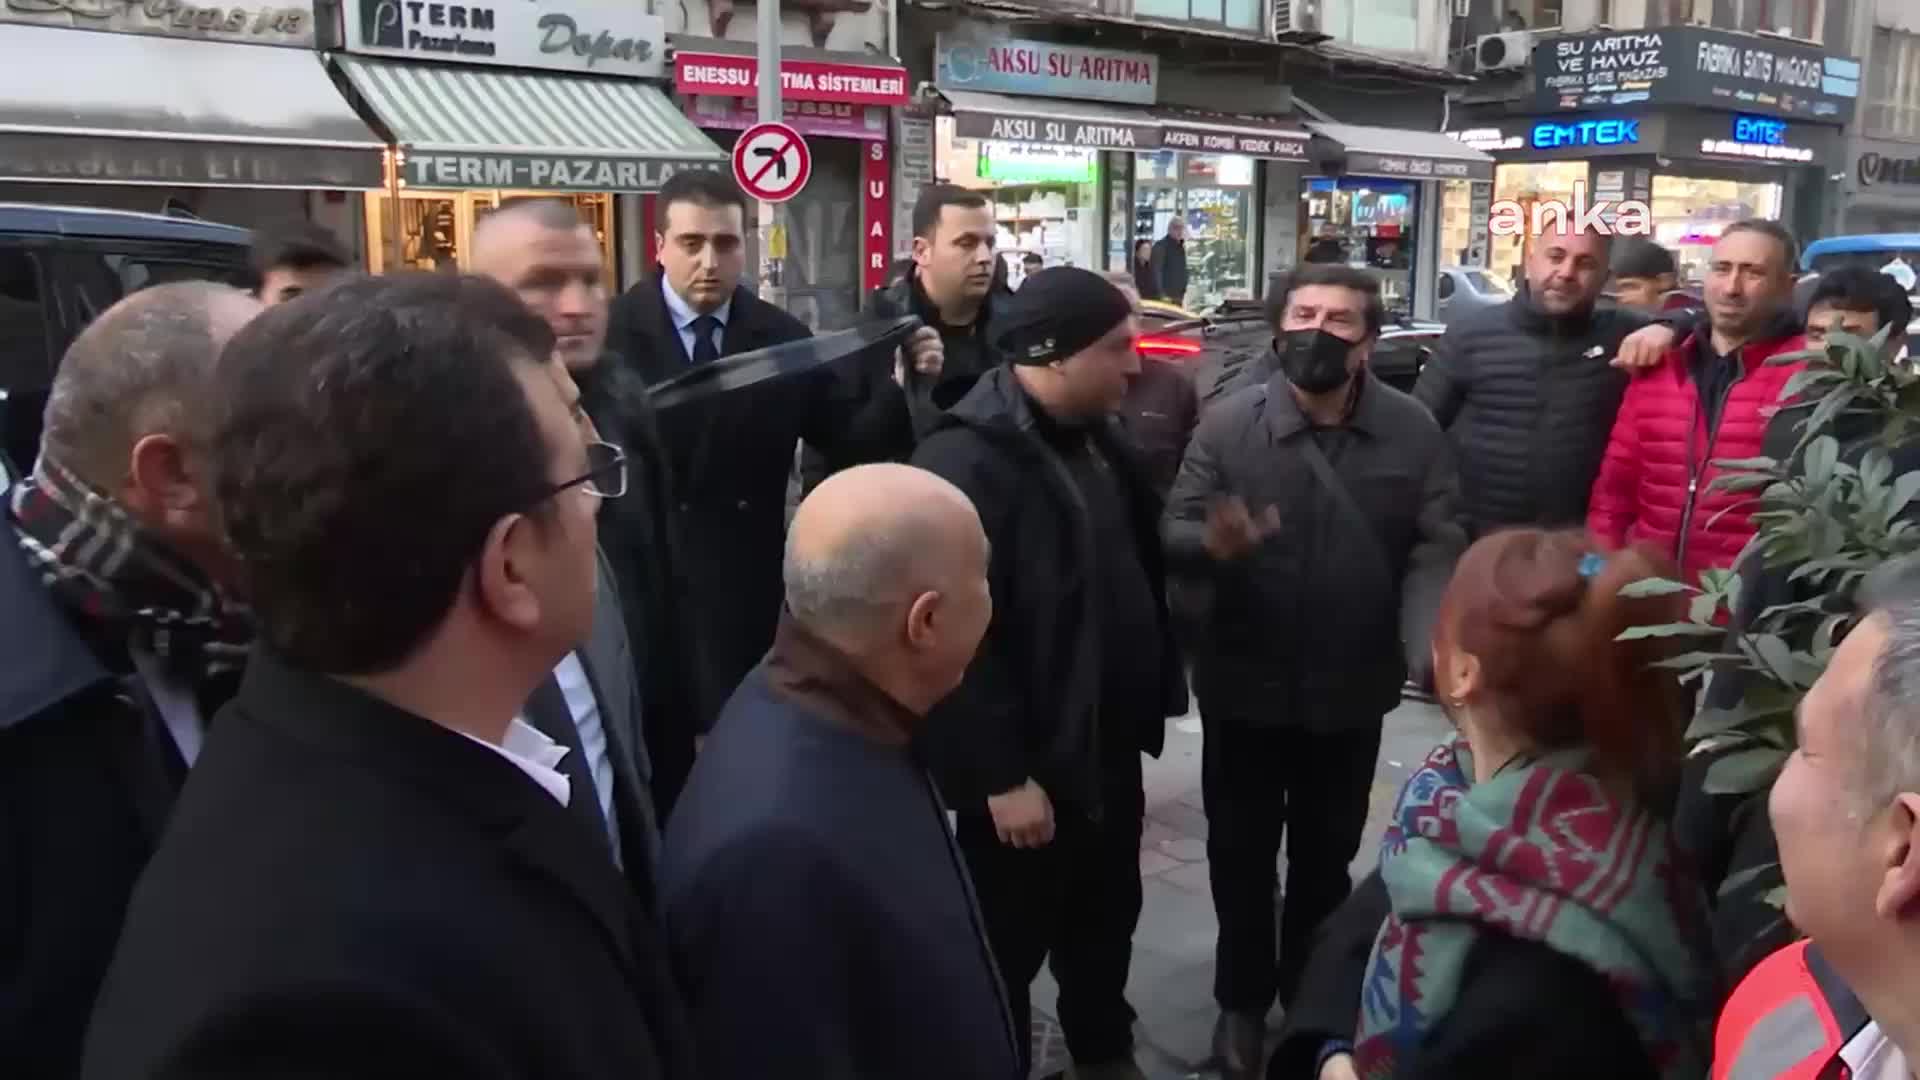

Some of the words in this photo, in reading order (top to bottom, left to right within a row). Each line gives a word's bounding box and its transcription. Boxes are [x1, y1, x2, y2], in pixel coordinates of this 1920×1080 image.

[407, 2, 494, 30] TERM
[1557, 41, 1584, 57] SU
[1591, 34, 1663, 53] ARITMA
[683, 65, 750, 85] ENESSU
[987, 47, 1040, 74] AKSU
[1048, 53, 1073, 77] SU
[1079, 55, 1151, 85] ARITMA
[1558, 57, 1584, 72] VE
[1591, 50, 1660, 70] HAVUZ
[991, 118, 1036, 140] AKSU
[1046, 122, 1066, 142] SU
[1075, 125, 1136, 146] ARITMA
[1533, 119, 1640, 148] EMTEK
[412, 155, 719, 186] TERM-PAZARLA
